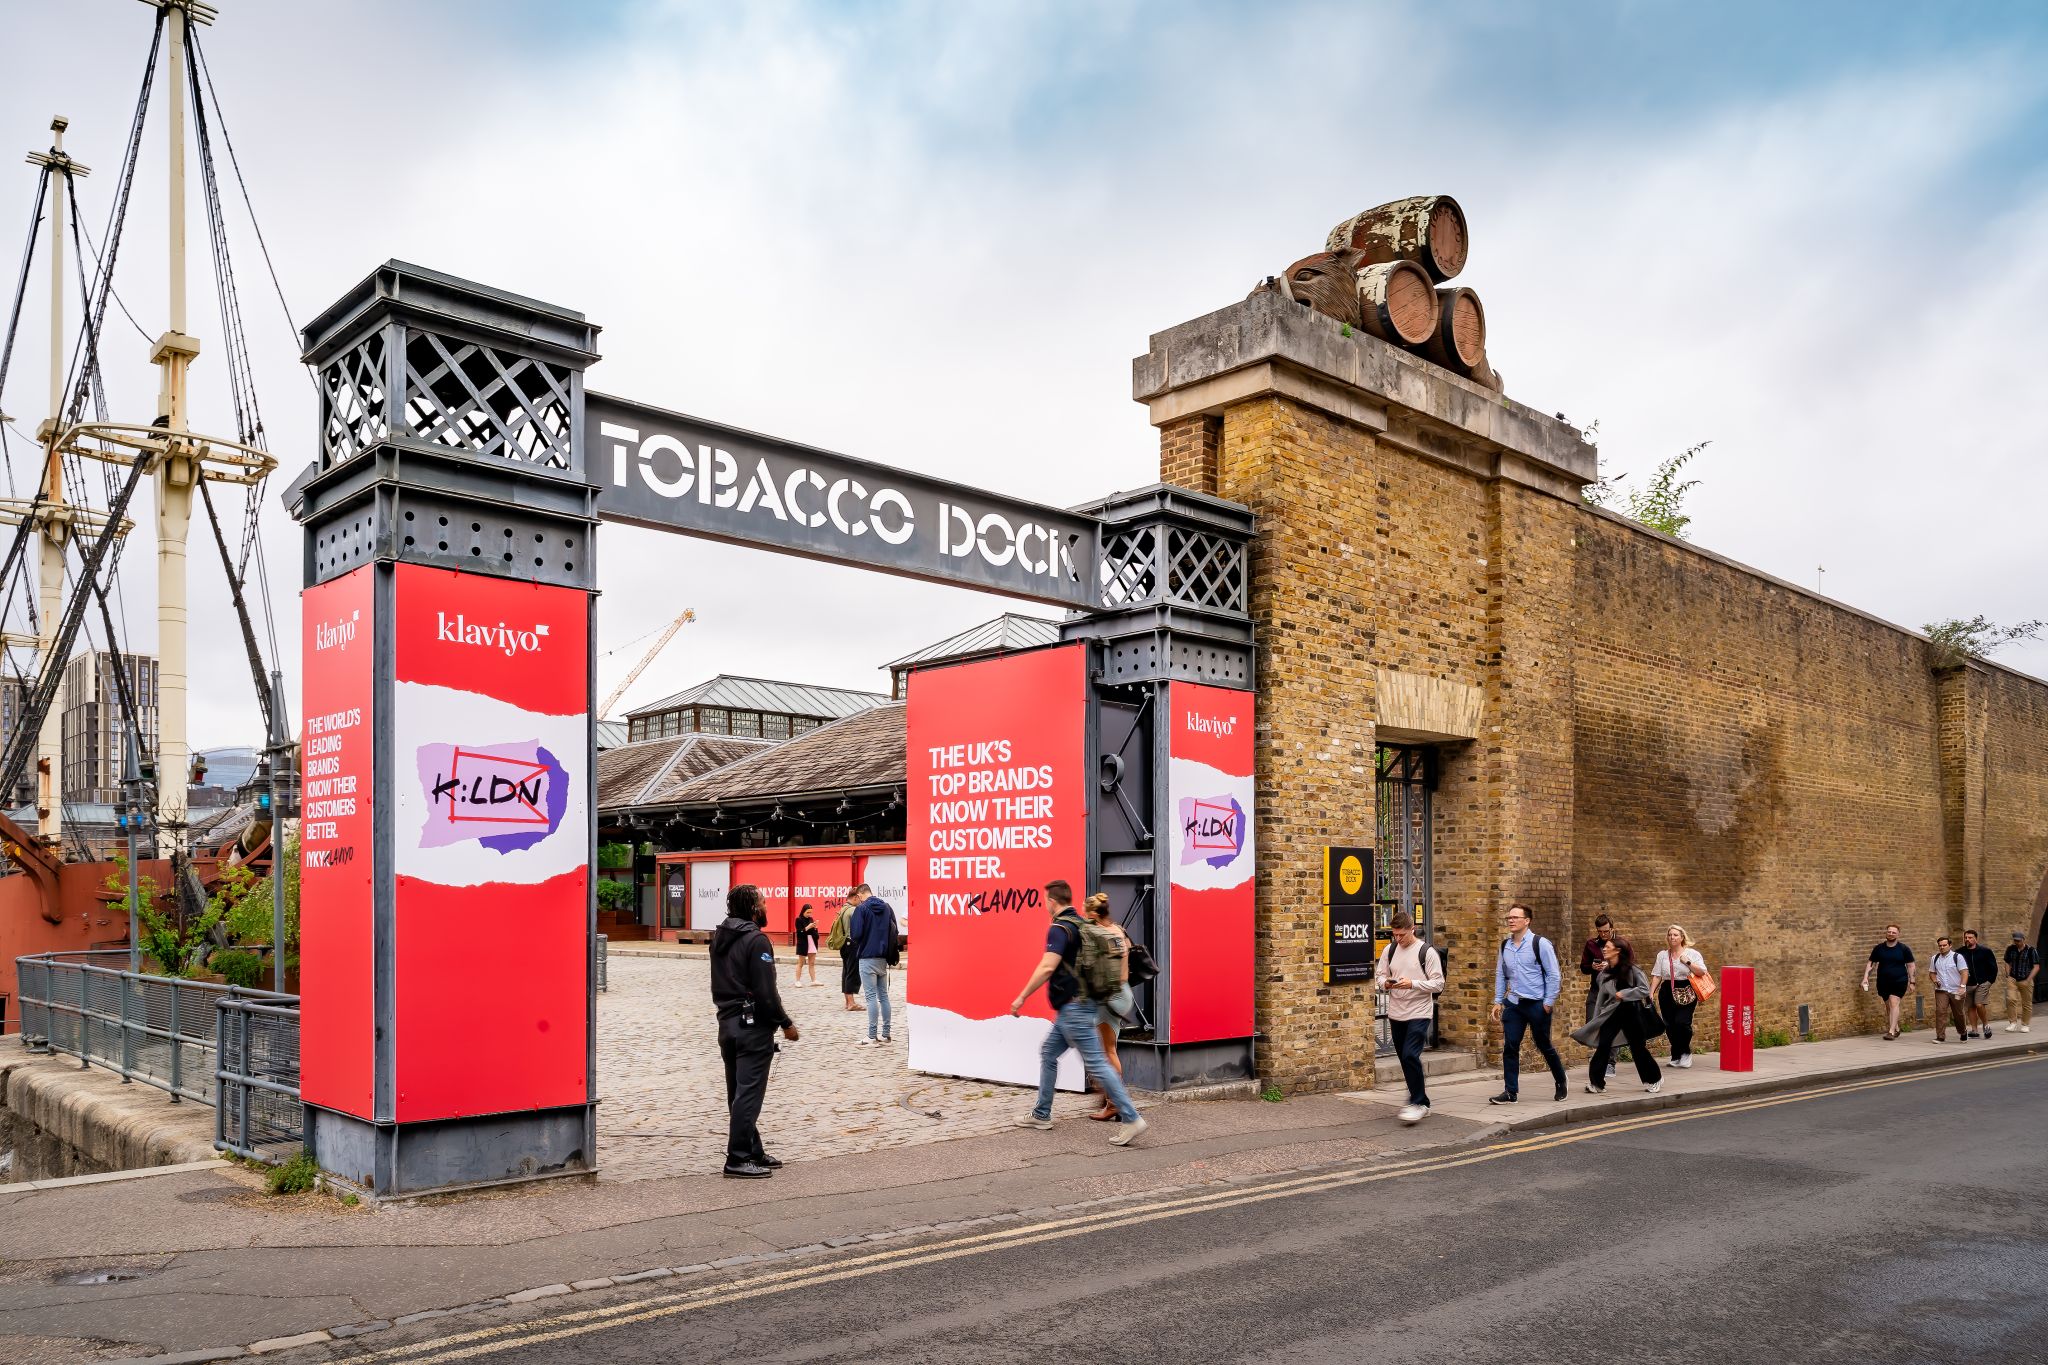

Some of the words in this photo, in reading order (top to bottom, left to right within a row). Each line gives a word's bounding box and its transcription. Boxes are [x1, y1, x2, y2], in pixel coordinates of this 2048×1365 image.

[600, 421, 915, 545] TOBACCO
[939, 502, 1079, 583] DOCK
[316, 617, 356, 652] klaviyo
[437, 612, 539, 656] klaviyo
[308, 716, 323, 735] THE
[324, 708, 360, 732] WORLD'S
[1187, 712, 1232, 738] klaviyo
[307, 735, 342, 757] LEADING
[929, 745, 964, 769] THE
[968, 740, 1012, 765] UK'S
[307, 756, 339, 777] BRANDS
[307, 779, 332, 798] KNOW
[333, 776, 356, 794] THEIR
[431, 773, 542, 806] K:LDN
[929, 773, 966, 797] TOP
[968, 765, 1053, 794] BRANDS
[307, 798, 356, 819] CUSTOMERS
[930, 799, 988, 824] KNOW
[992, 795, 1054, 820] THEIR
[306, 822, 338, 840] BETTER.
[929, 824, 1052, 852] CUSTOMERS
[1185, 817, 1233, 838] K:LDN
[930, 856, 1005, 879] BETTER.
[794, 886, 816, 898] BUILT
[817, 886, 836, 898] FOR
[1334, 924, 1343, 932] the
[1343, 923, 1369, 939] DOCK
